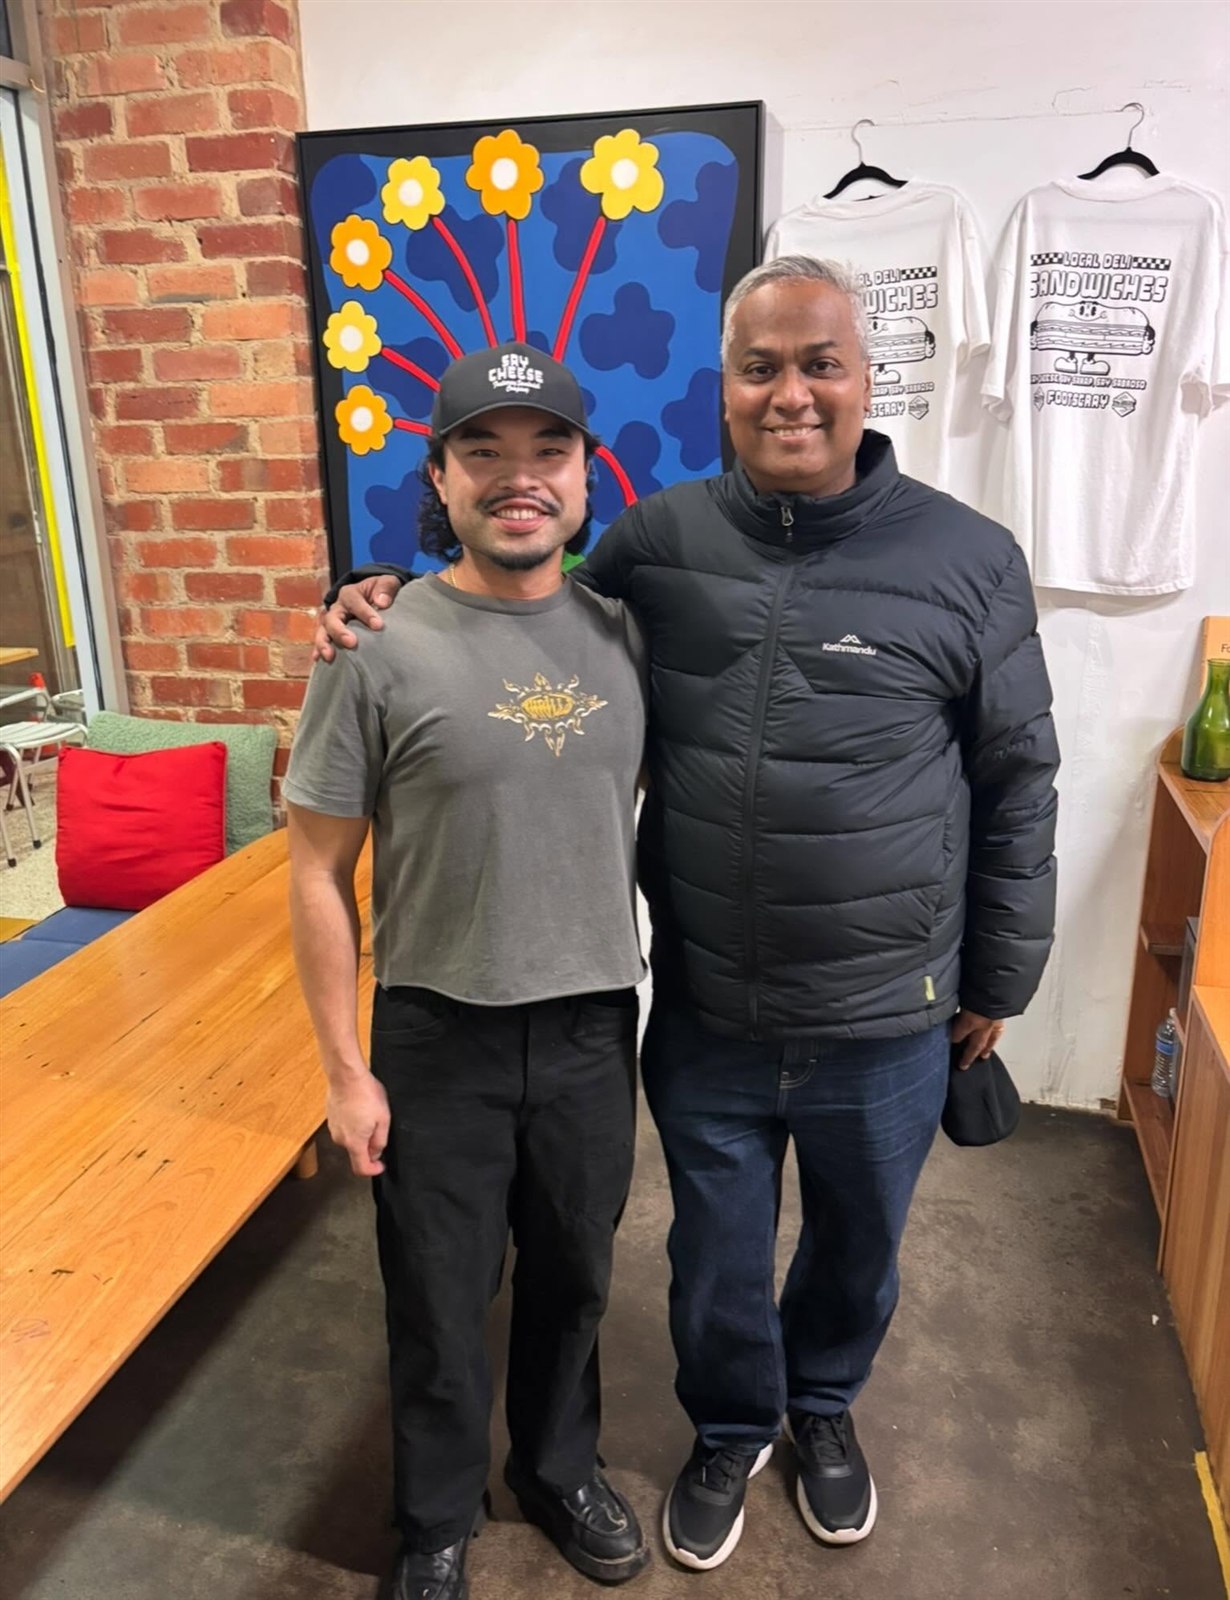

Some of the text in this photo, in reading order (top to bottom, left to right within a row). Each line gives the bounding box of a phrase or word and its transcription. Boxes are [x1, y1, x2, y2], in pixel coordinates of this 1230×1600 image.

[1063, 251, 1133, 270] LOCAL DELI
[874, 268, 902, 286] DELI
[1031, 270, 1169, 303] SANDWICHES
[863, 282, 939, 315] WICHES
[501, 353, 529, 369] SAY
[488, 365, 544, 384] CHEESE
[1046, 389, 1110, 409] FOOTSCRAY
[822, 642, 877, 656] Kathmandu
